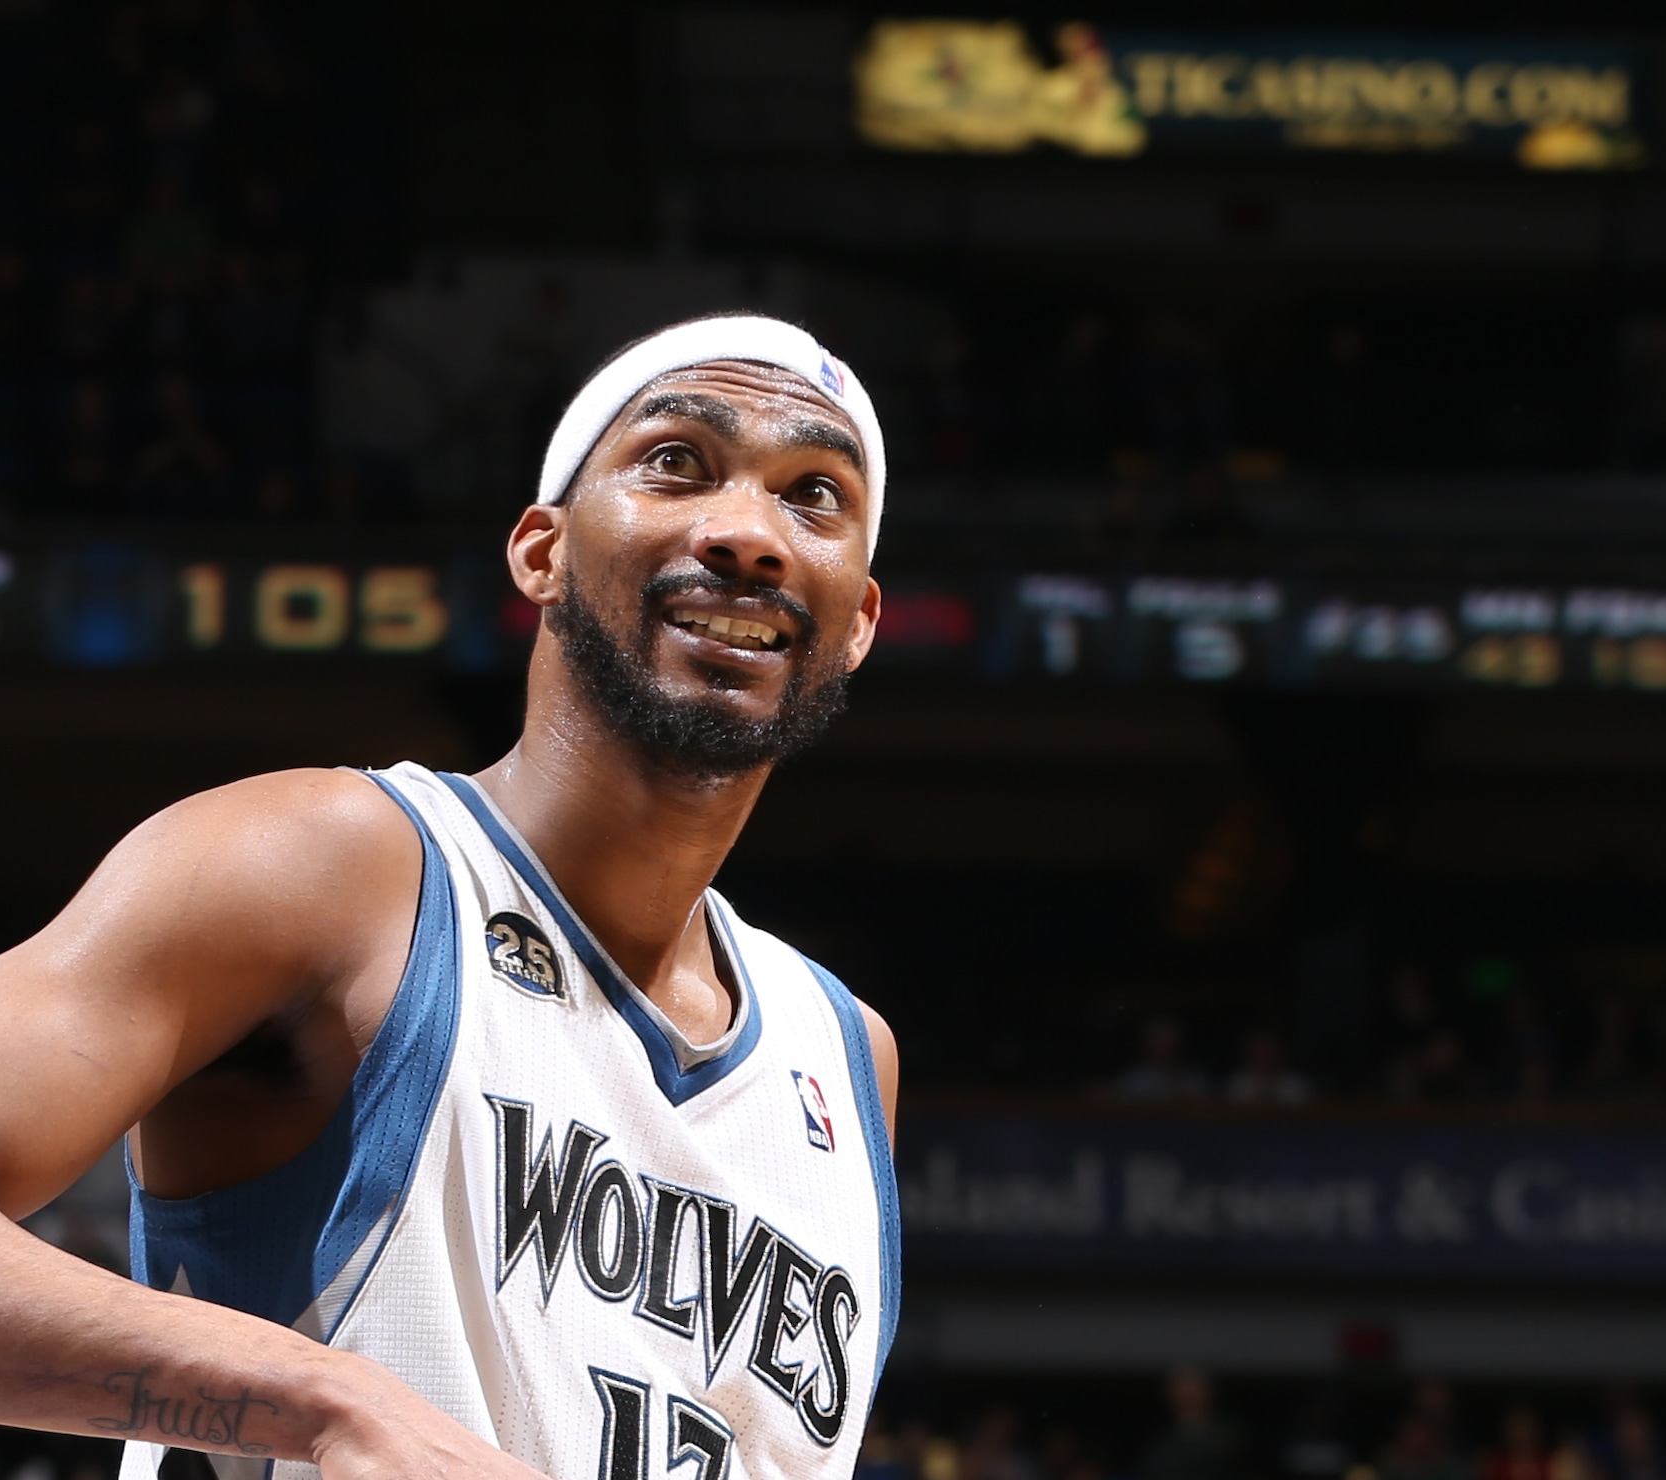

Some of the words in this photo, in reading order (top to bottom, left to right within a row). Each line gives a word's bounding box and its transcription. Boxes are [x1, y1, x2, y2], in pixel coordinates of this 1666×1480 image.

[180, 563, 447, 652] 105
[493, 923, 556, 984] 25
[808, 1128, 829, 1148] NBA
[485, 1094, 862, 1448] WOLVES
[88, 1362, 279, 1455] Trust
